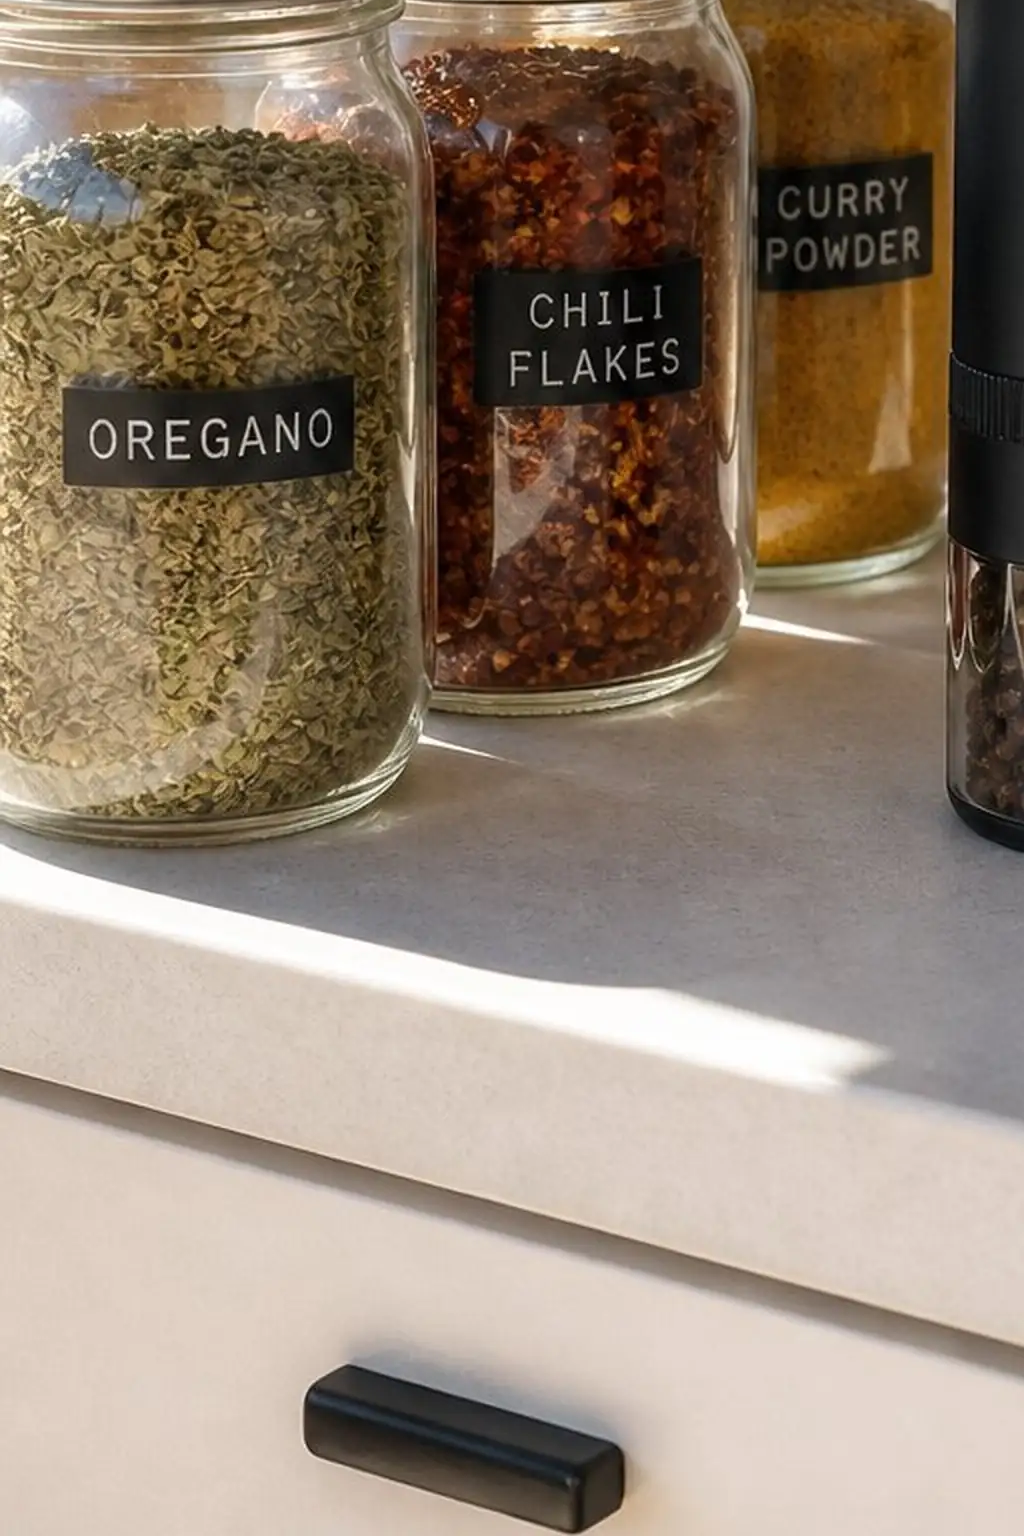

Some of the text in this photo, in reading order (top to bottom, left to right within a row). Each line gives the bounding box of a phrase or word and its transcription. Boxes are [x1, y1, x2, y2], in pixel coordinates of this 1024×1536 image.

[778, 177, 909, 221] CURRY
[766, 226, 921, 273] POWDER
[529, 285, 664, 329] CHILI
[509, 338, 680, 387] FLAKES
[89, 408, 333, 460] OREGANO
